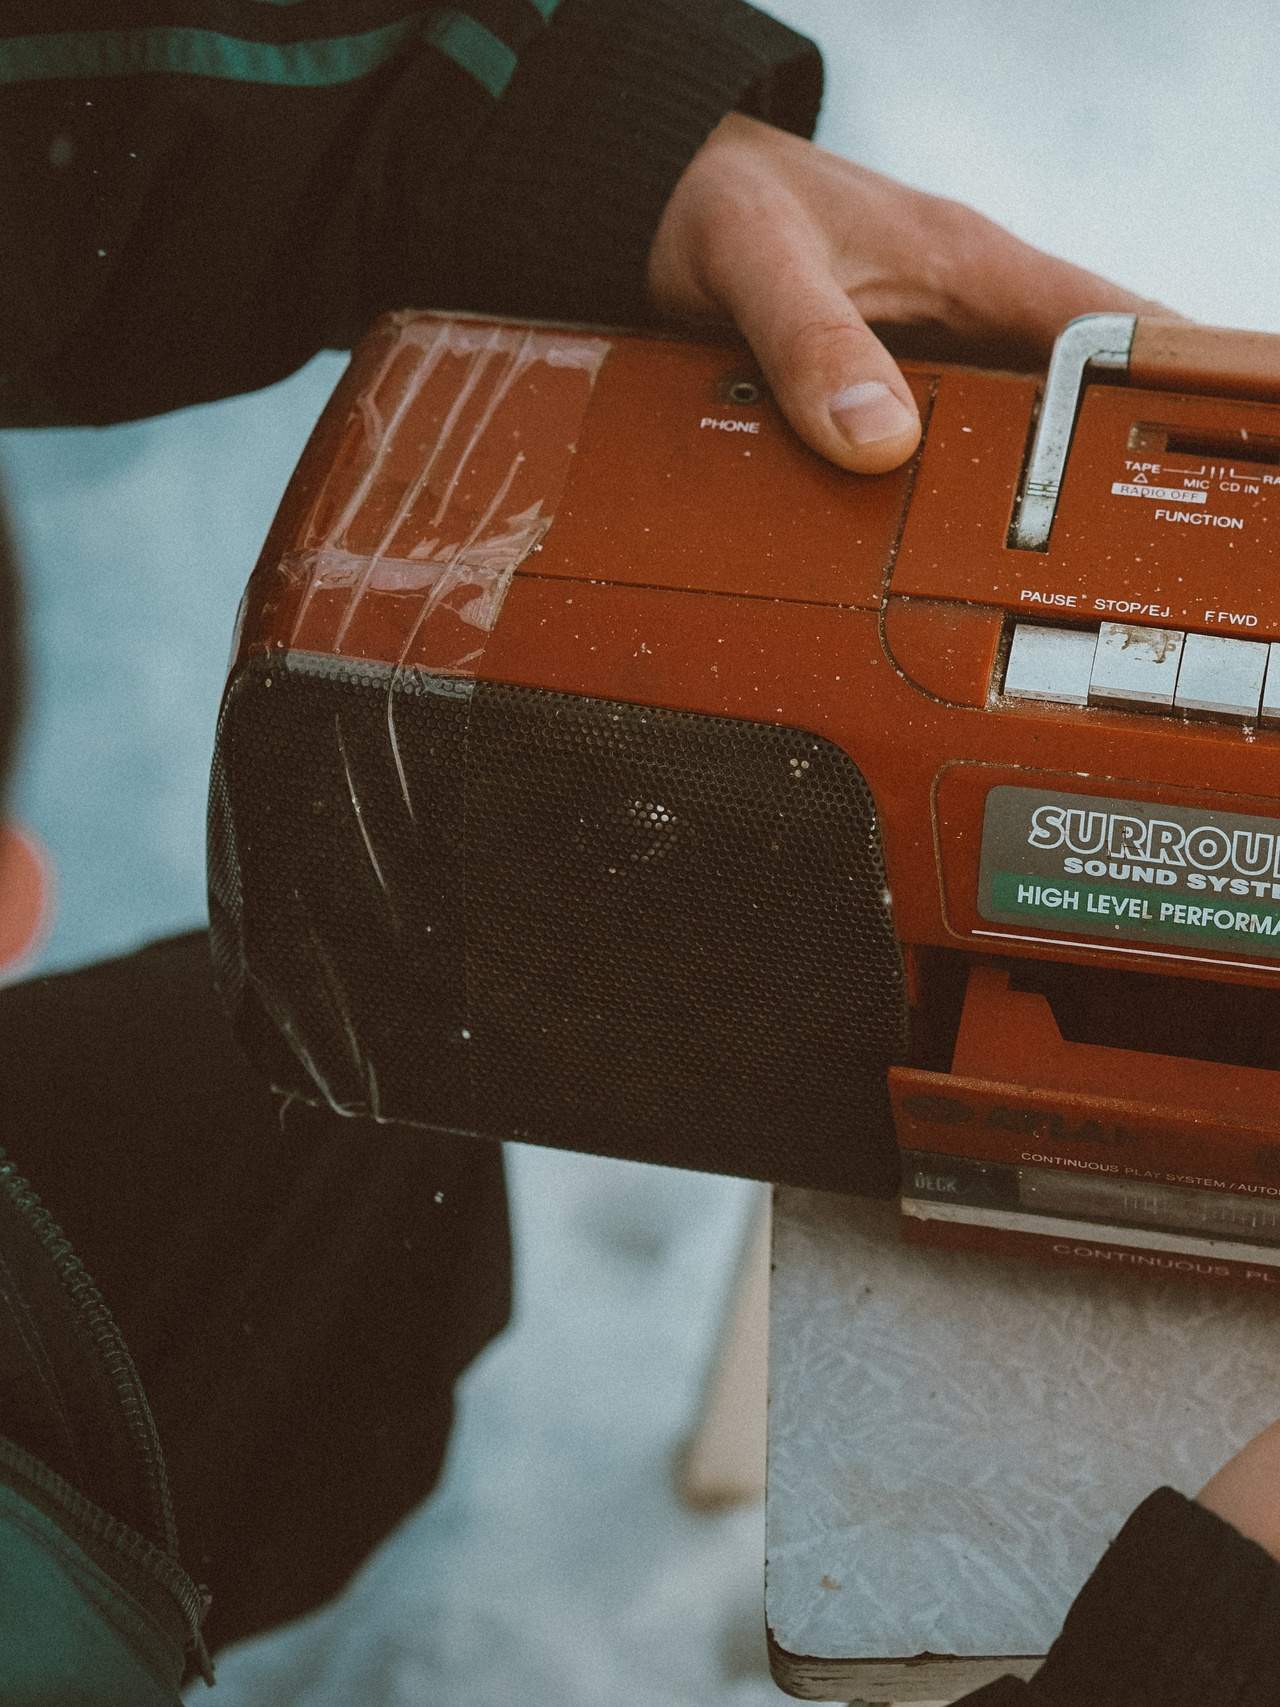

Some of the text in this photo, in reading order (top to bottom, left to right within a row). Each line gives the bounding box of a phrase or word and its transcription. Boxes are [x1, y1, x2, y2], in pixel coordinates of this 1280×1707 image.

[701, 417, 760, 434] PHONE
[1125, 460, 1161, 474] TAPE
[1184, 478, 1210, 489] MIC
[1219, 482, 1259, 494] CD IN
[1120, 485, 1199, 501] RADIO OFF
[1154, 509, 1244, 530] FUNCTION
[1020, 590, 1077, 607] PAUSE
[1063, 857, 1177, 886] SOUND
[1017, 884, 1078, 910] HIGH
[1087, 893, 1152, 920] LEVEL
[1021, 1152, 1119, 1173] CONTINUOUS
[1124, 1167, 1161, 1179] PLAY
[1053, 1244, 1229, 1276] CONTINUOUS
